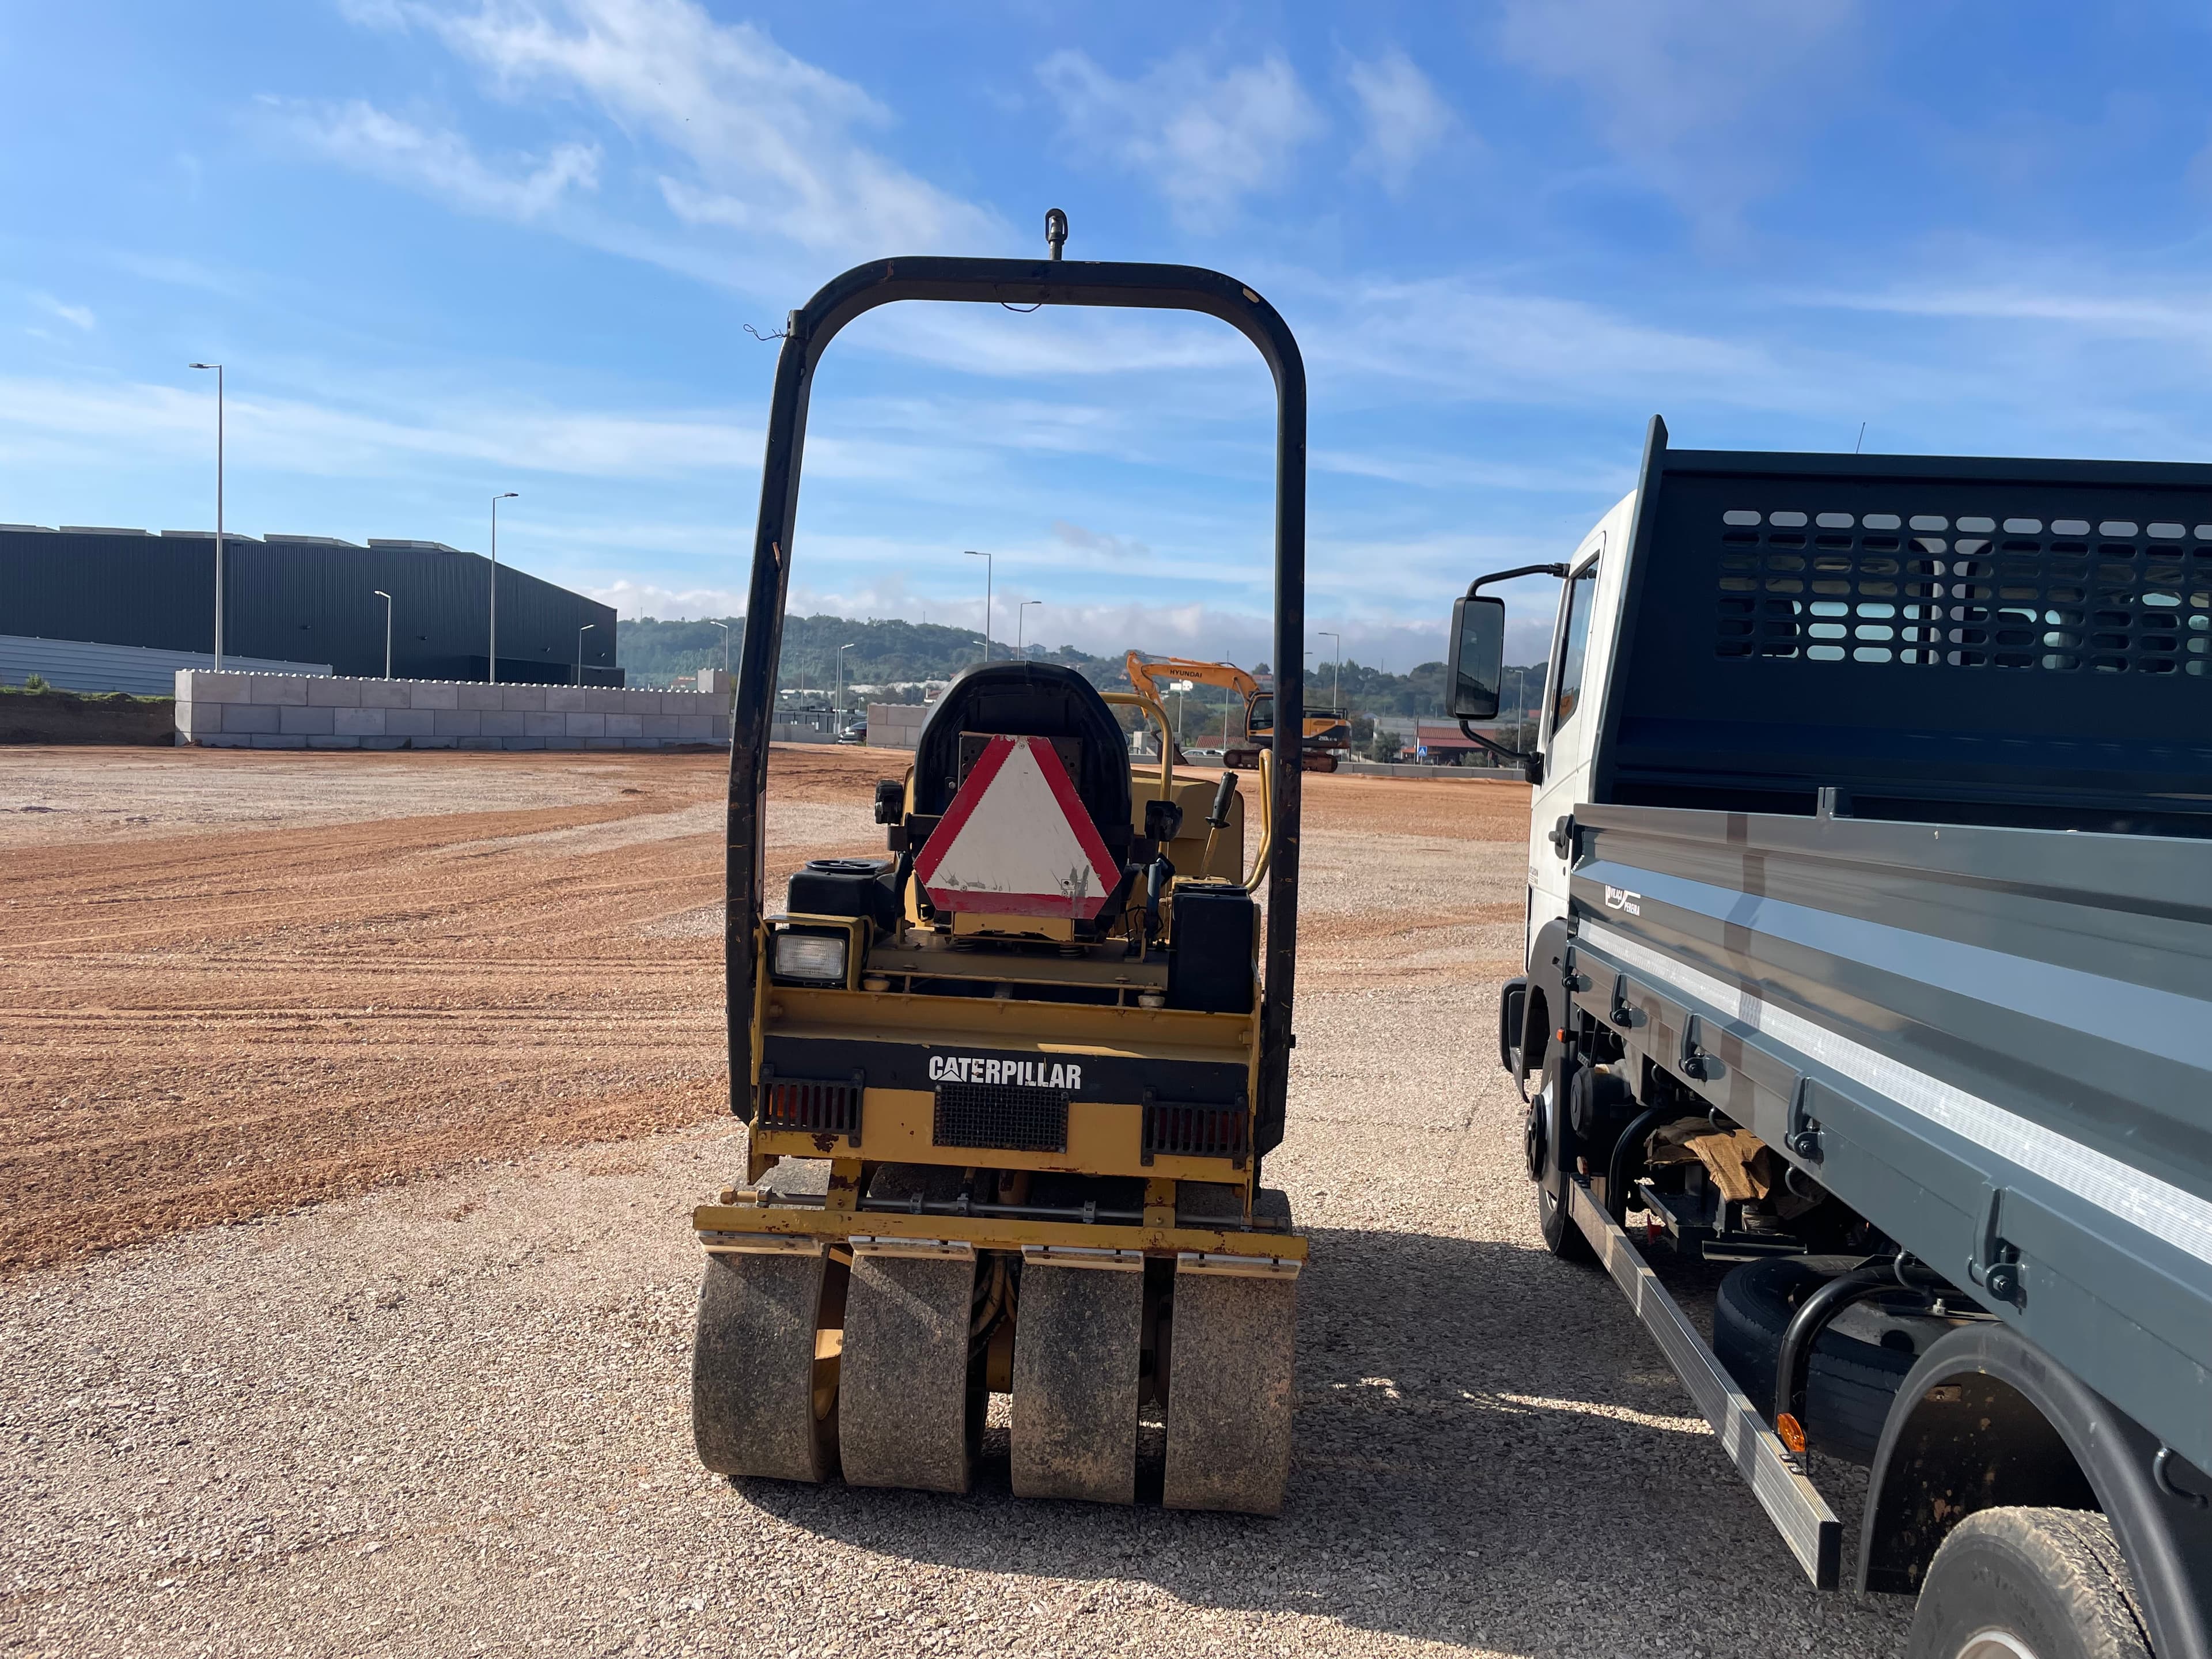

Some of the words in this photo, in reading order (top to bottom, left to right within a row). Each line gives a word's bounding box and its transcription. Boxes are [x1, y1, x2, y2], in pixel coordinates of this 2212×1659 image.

[1170, 669, 1202, 678] HYUNDAI
[1624, 901, 1640, 916] PEREIRA
[929, 1055, 1081, 1089] CATERPILLAR
